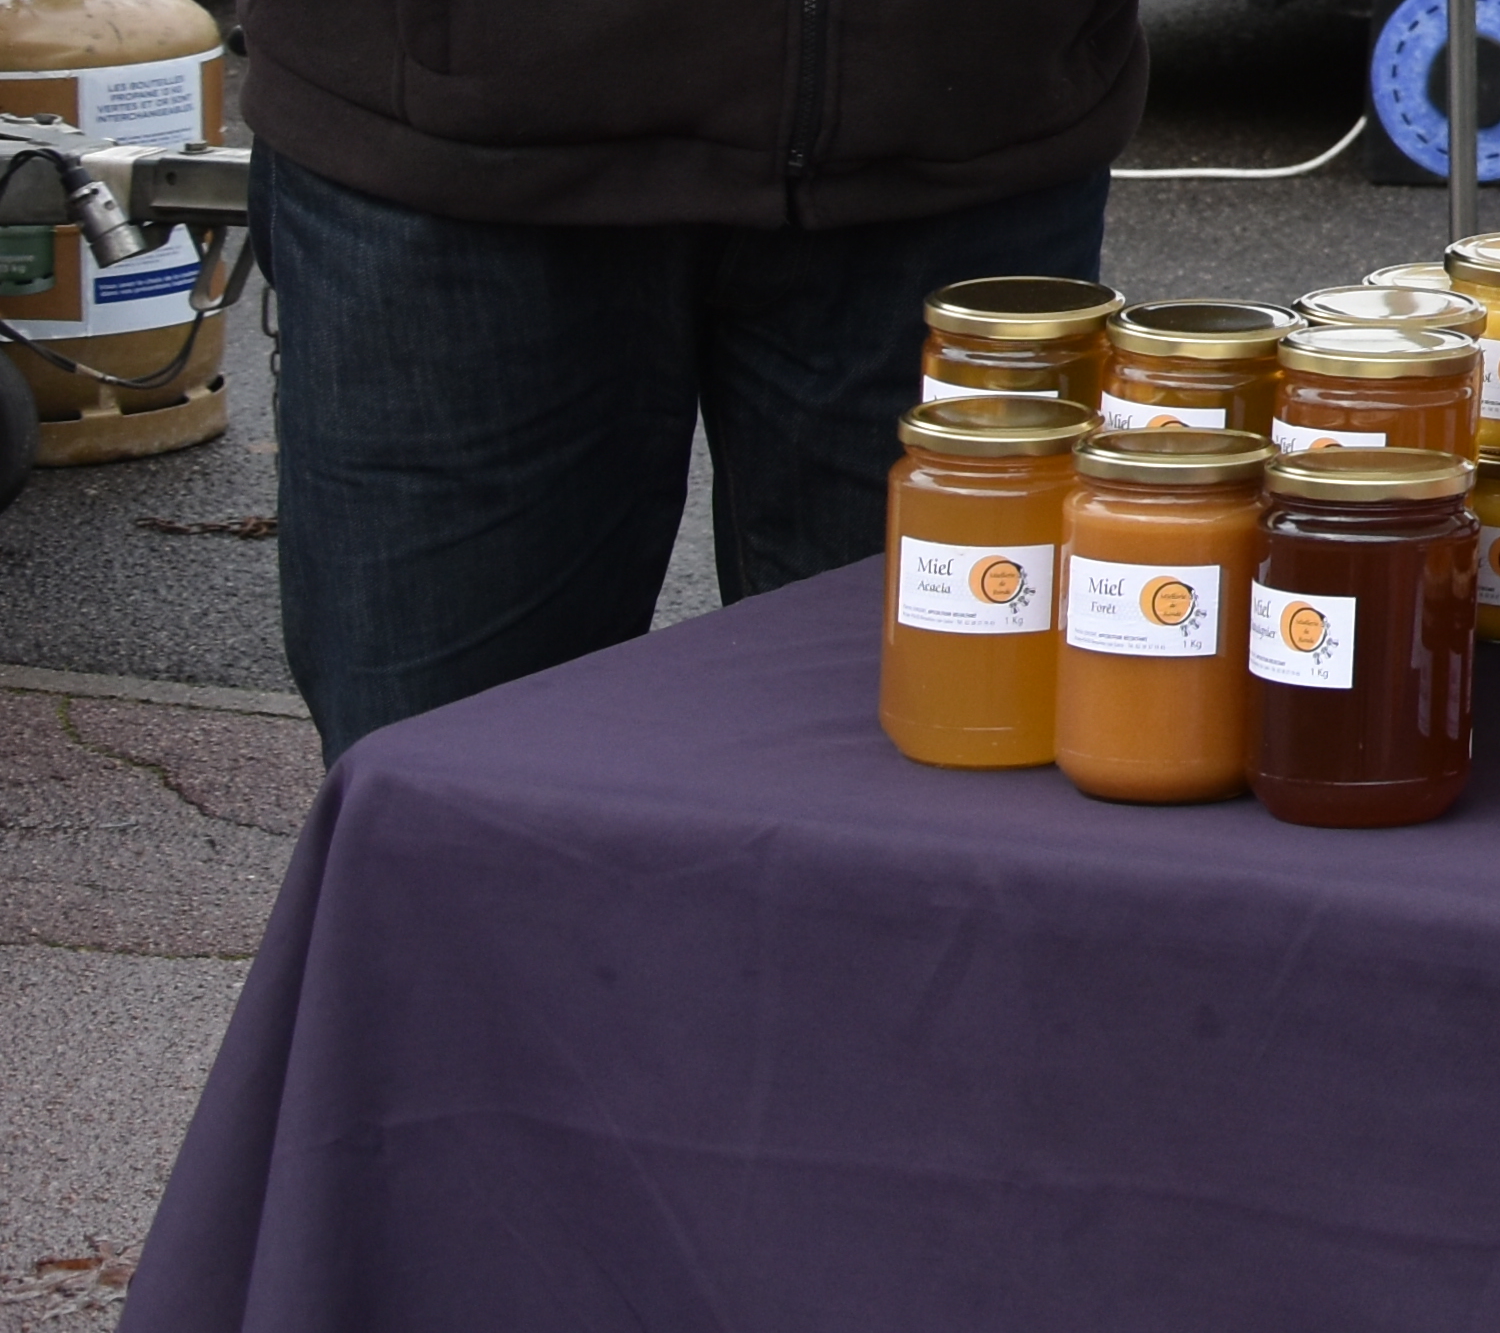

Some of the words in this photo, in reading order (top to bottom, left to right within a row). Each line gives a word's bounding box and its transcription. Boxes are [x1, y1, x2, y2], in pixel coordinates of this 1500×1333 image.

[917, 556, 955, 576] Miel
[917, 581, 951, 594] Acacia
[1088, 577, 1126, 597] Miel
[1091, 602, 1116, 615] Forêt
